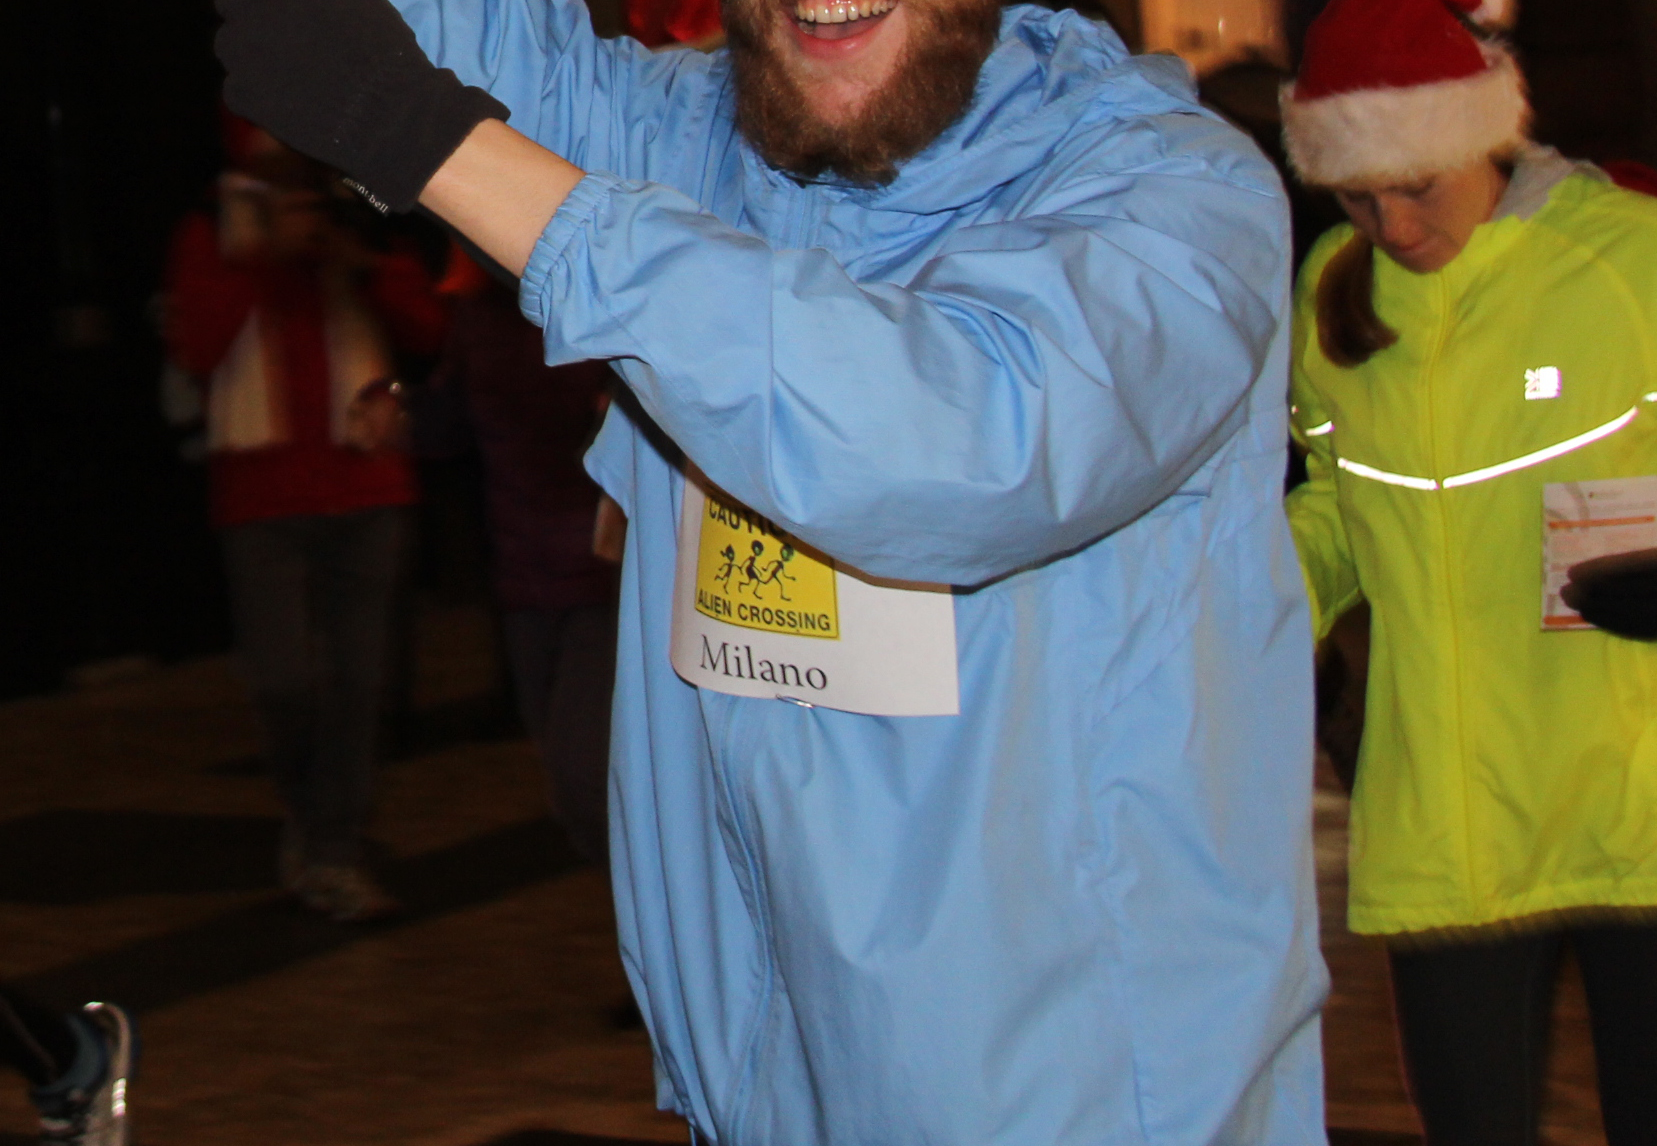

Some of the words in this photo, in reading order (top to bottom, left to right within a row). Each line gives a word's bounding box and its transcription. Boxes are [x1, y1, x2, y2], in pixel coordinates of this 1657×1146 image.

[698, 588, 732, 617] ALIEN
[738, 603, 831, 631] CROSSING
[700, 634, 828, 690] Milano
